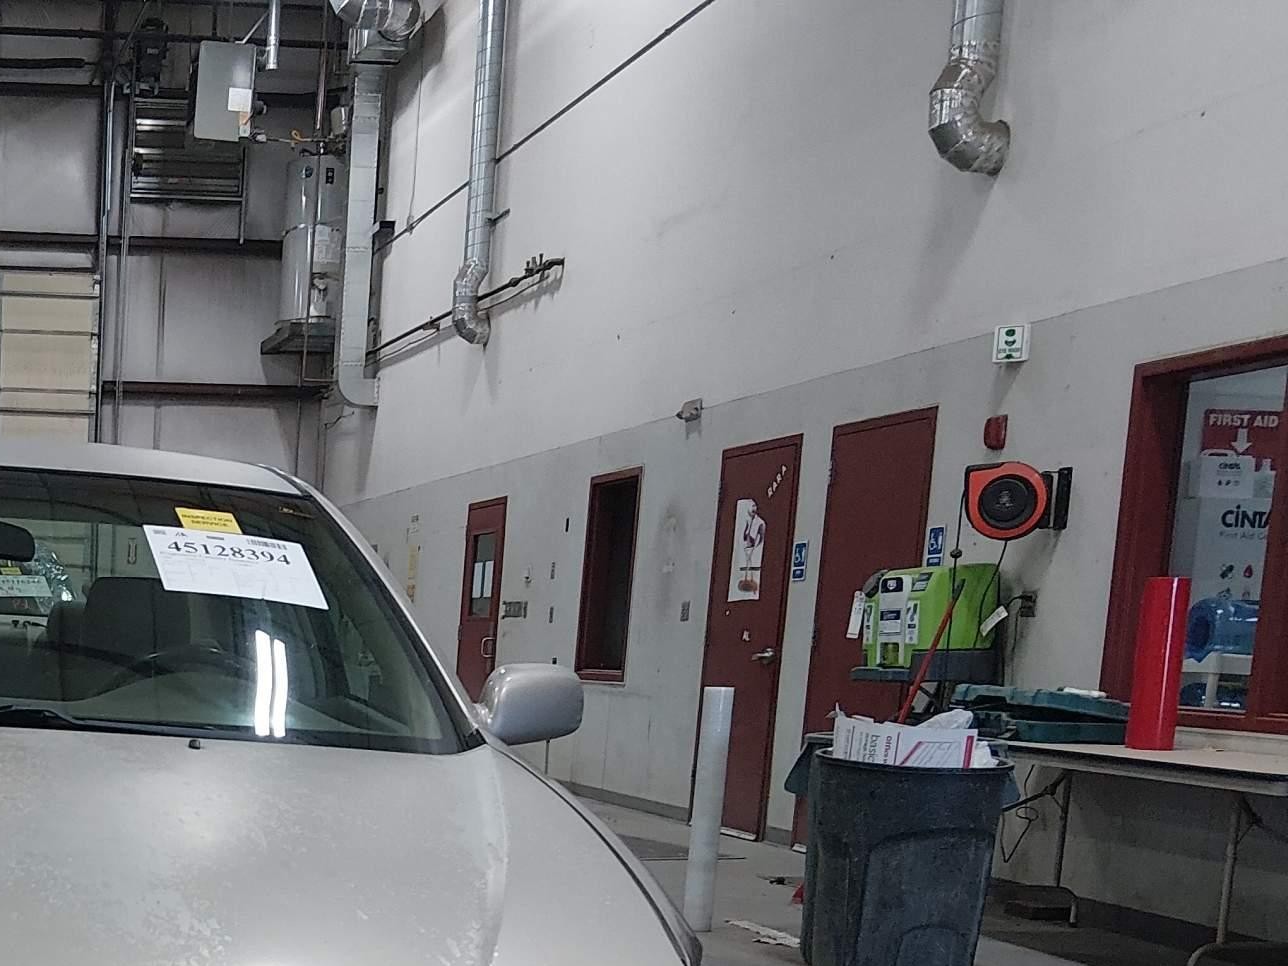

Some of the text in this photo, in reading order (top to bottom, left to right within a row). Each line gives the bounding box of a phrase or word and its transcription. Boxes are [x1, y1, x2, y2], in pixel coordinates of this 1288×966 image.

[1208, 413, 1279, 428] FIRST AID
[167, 541, 291, 566] 45128394
